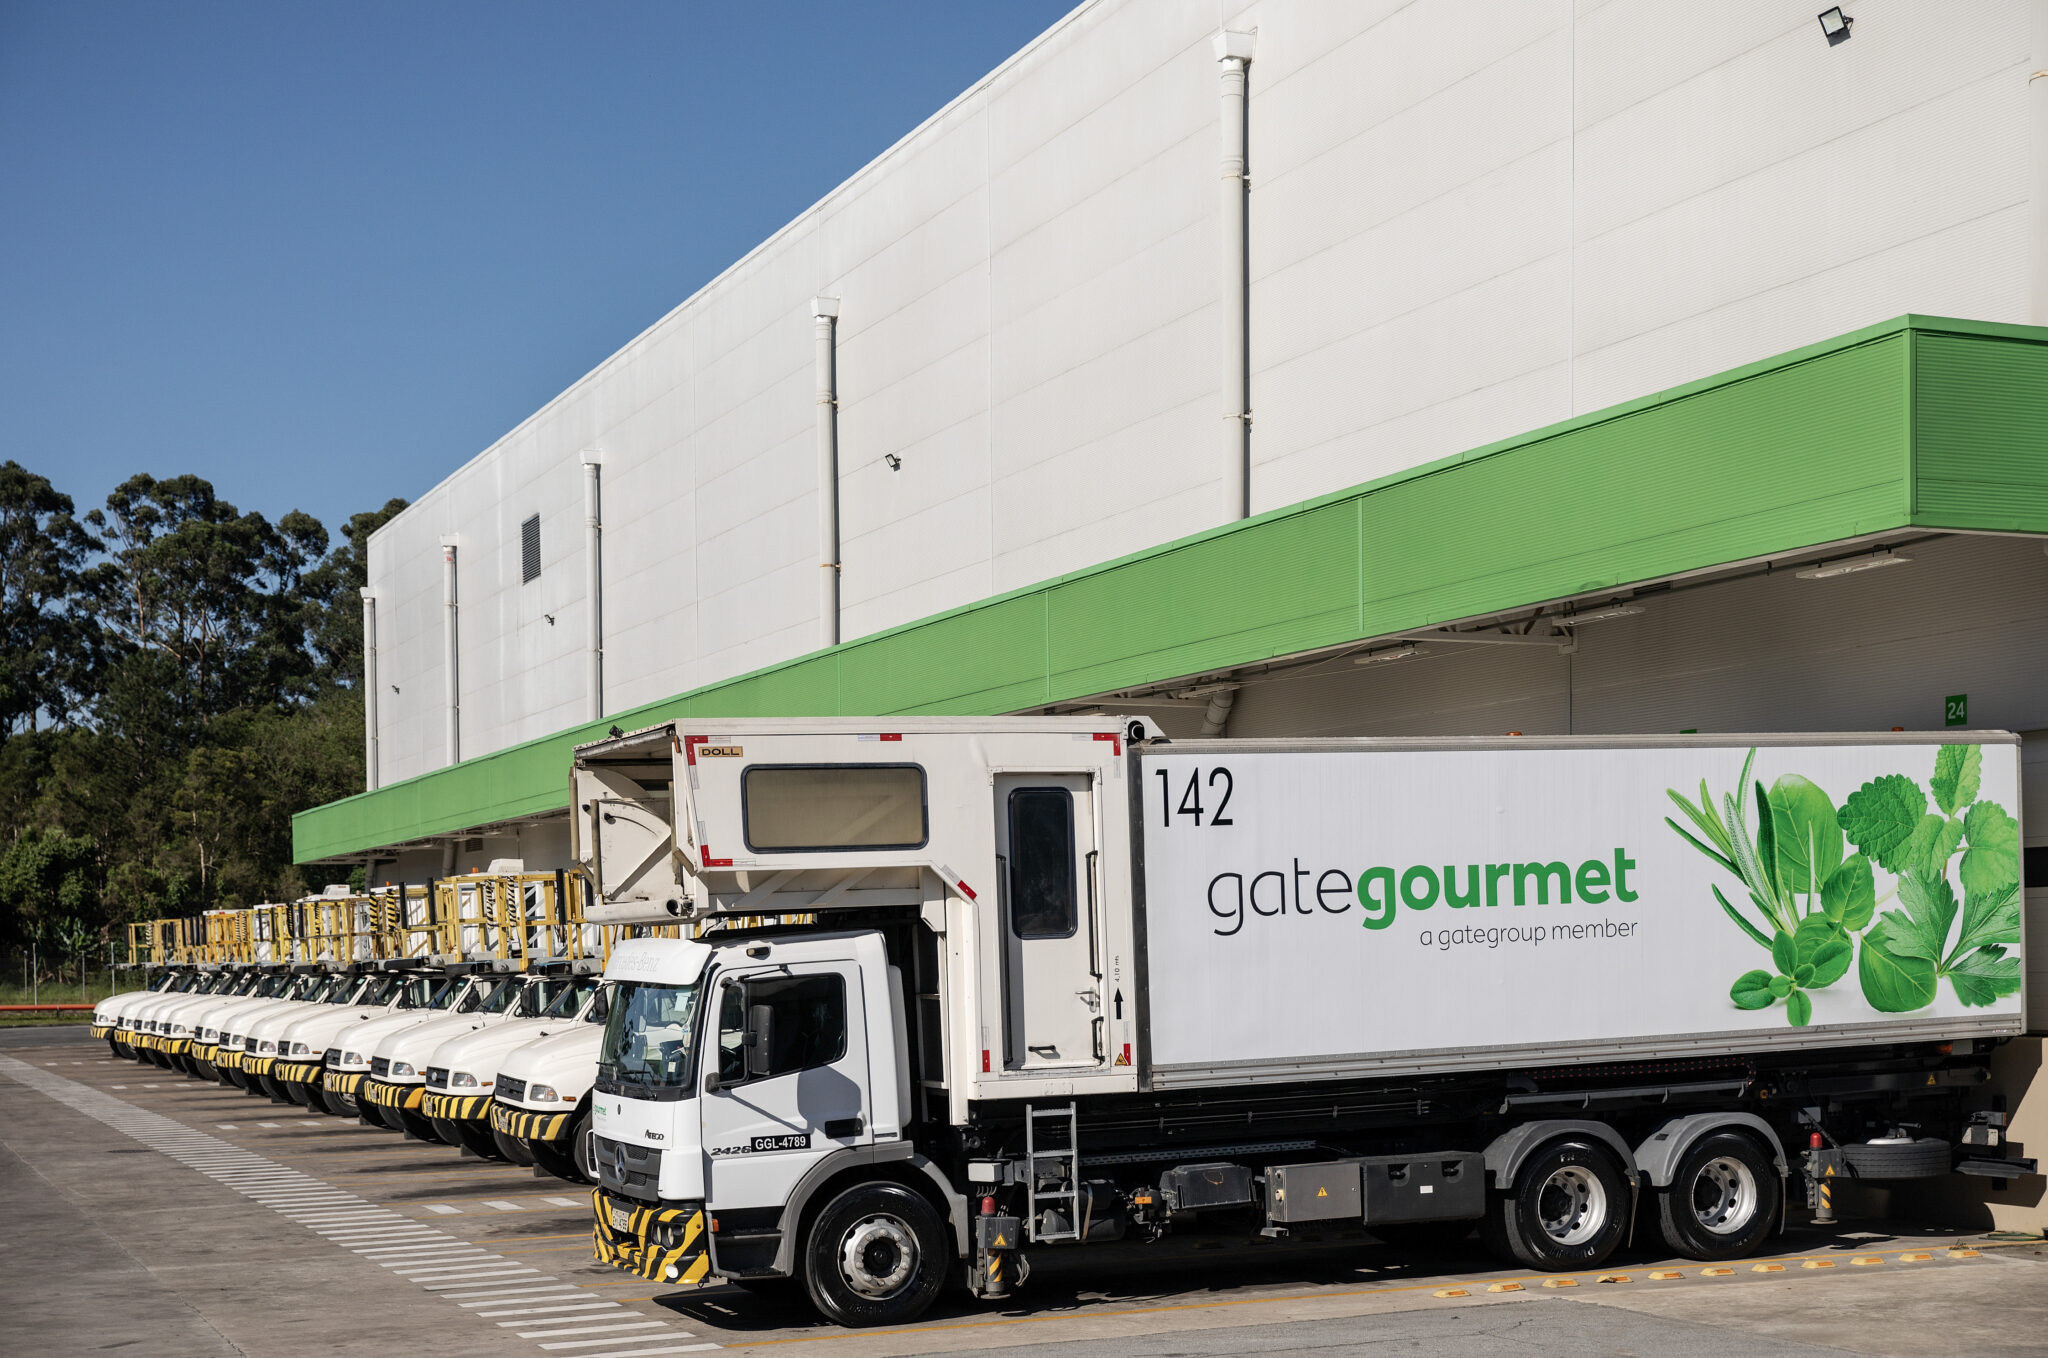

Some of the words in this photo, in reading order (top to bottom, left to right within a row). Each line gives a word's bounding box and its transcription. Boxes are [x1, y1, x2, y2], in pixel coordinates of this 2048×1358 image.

[1947, 701, 1965, 719] 24
[701, 748, 740, 756] DOLL
[1156, 766, 1234, 828] 142
[1207, 847, 1639, 937] gategourmet
[1419, 931, 1433, 946] a
[1438, 925, 1547, 951] gategroup
[1551, 917, 1639, 941] member
[711, 1146, 752, 1156] 2426
[755, 1135, 806, 1150] GGL-4789
